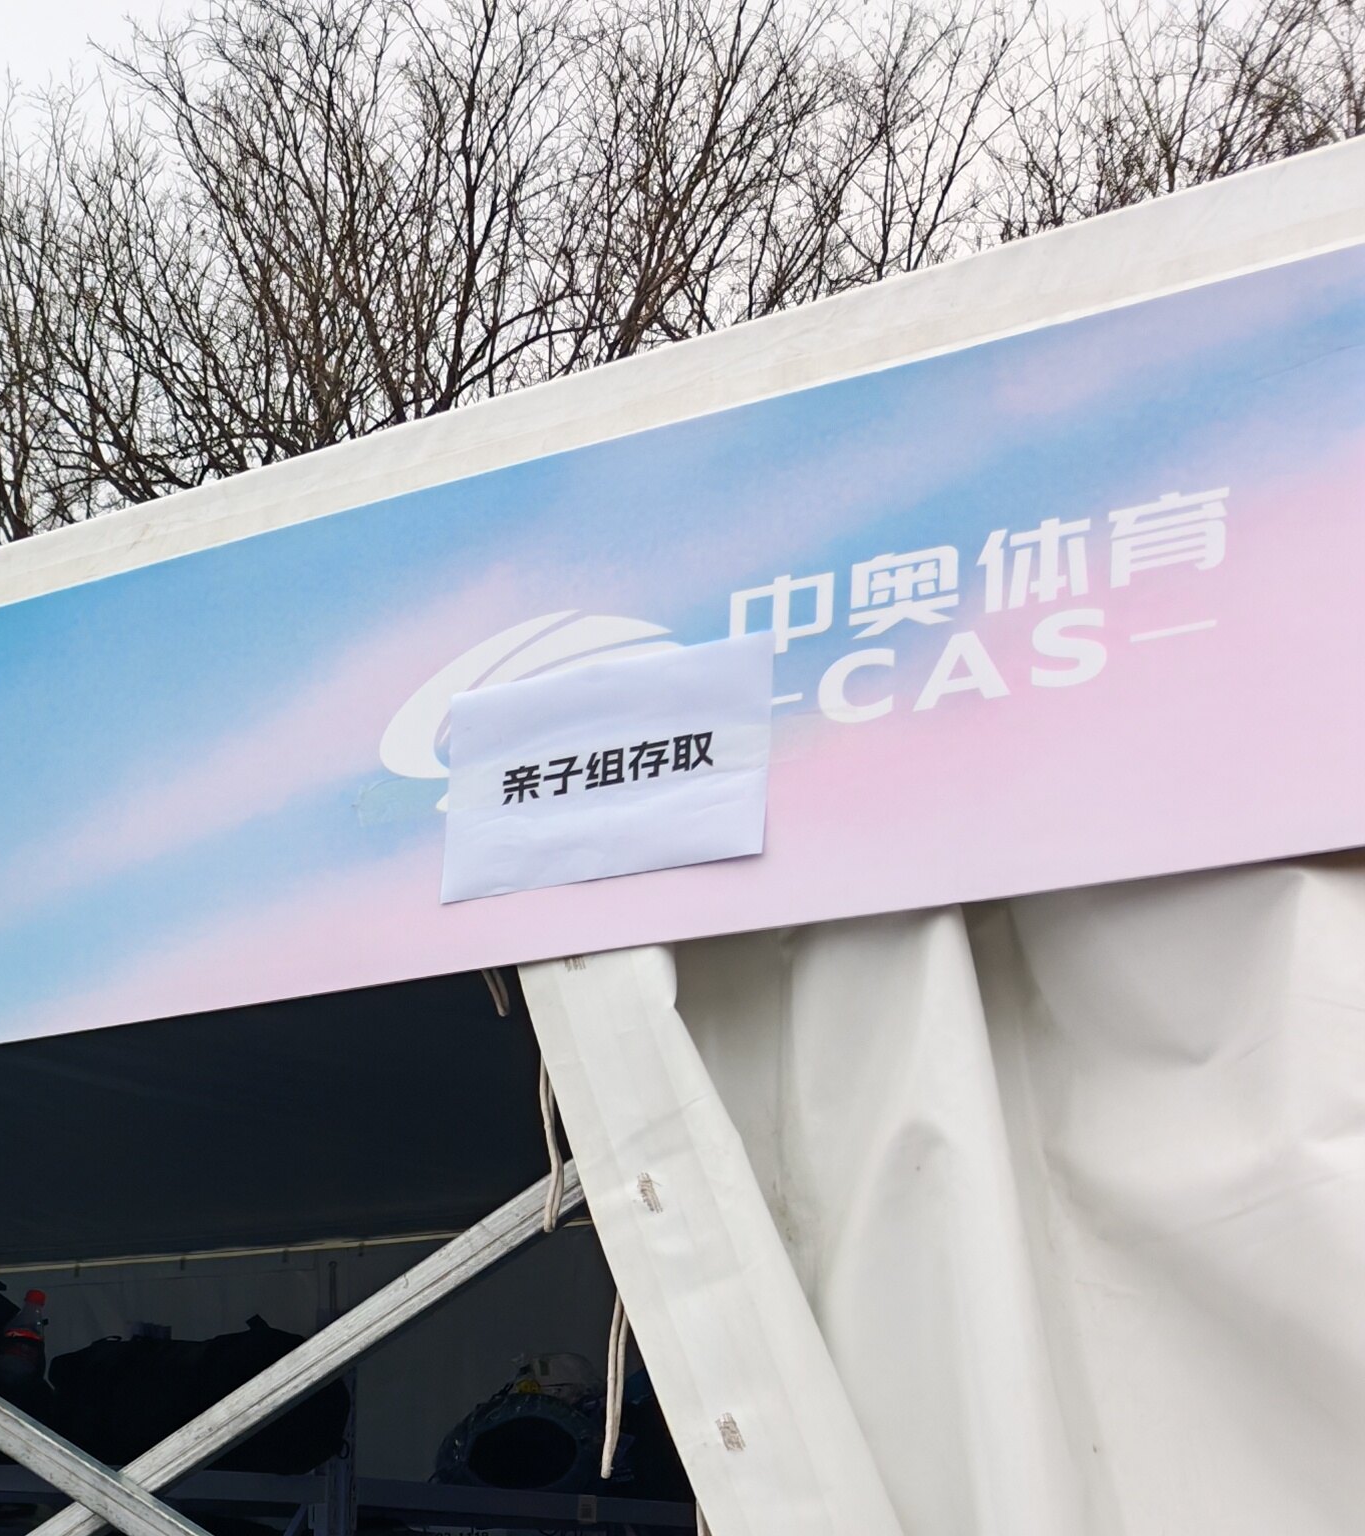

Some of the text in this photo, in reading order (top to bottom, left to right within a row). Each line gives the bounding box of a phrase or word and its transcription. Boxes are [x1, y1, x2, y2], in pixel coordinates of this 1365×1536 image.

[729, 486, 1232, 656] 中奥体育
[817, 609, 1109, 724] CAS
[500, 730, 715, 807] 亲子组存取
